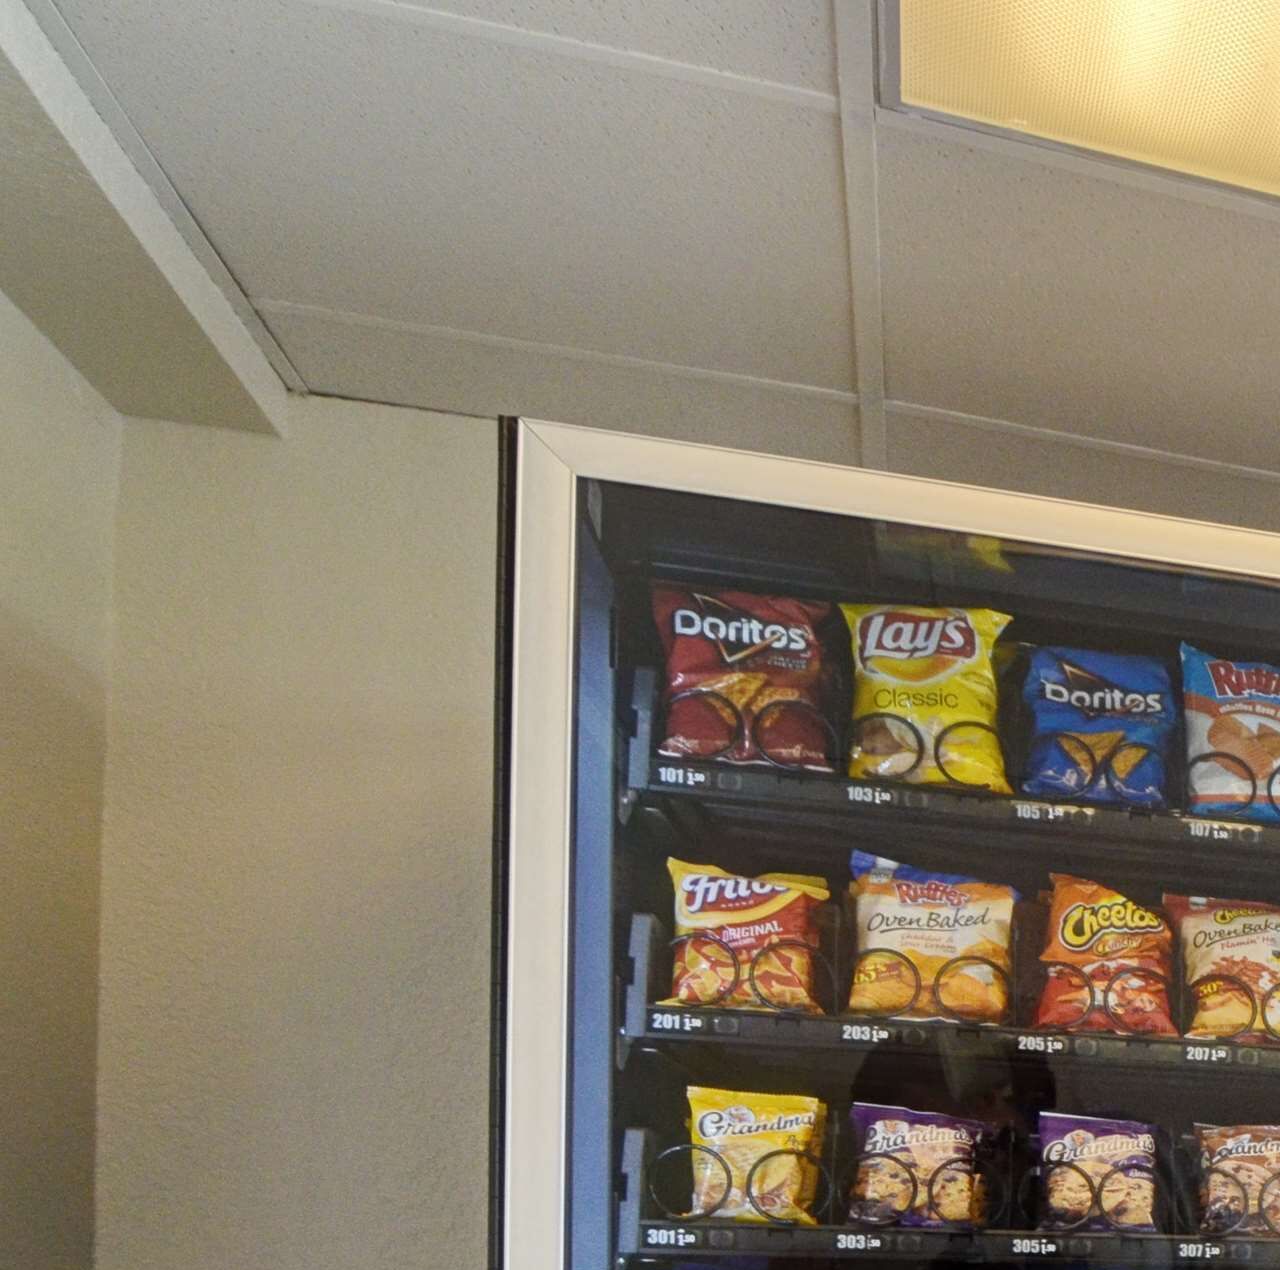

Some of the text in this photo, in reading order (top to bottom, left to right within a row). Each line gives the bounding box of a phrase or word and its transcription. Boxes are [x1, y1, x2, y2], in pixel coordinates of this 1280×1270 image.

[675, 608, 808, 652] Doritos
[862, 614, 968, 658] Lay's
[873, 689, 958, 710] Classic
[1042, 680, 1163, 713] Doritos
[659, 767, 683, 784] 101
[847, 787, 872, 803] 103
[1017, 805, 1040, 819] 105
[1190, 822, 1211, 836] 107
[868, 908, 990, 932] Oven Baked
[1063, 902, 1161, 950] Cheetos
[722, 920, 783, 940] ORIGINAL
[1193, 926, 1240, 949] Oven
[653, 1014, 681, 1029] 201
[843, 1026, 871, 1040] 203
[1019, 1037, 1044, 1050] 205
[1187, 1047, 1210, 1060] 207
[648, 1229, 676, 1244] 301
[838, 1236, 865, 1249] 303
[1013, 1239, 1040, 1253] 305
[1180, 1244, 1202, 1257] 307
